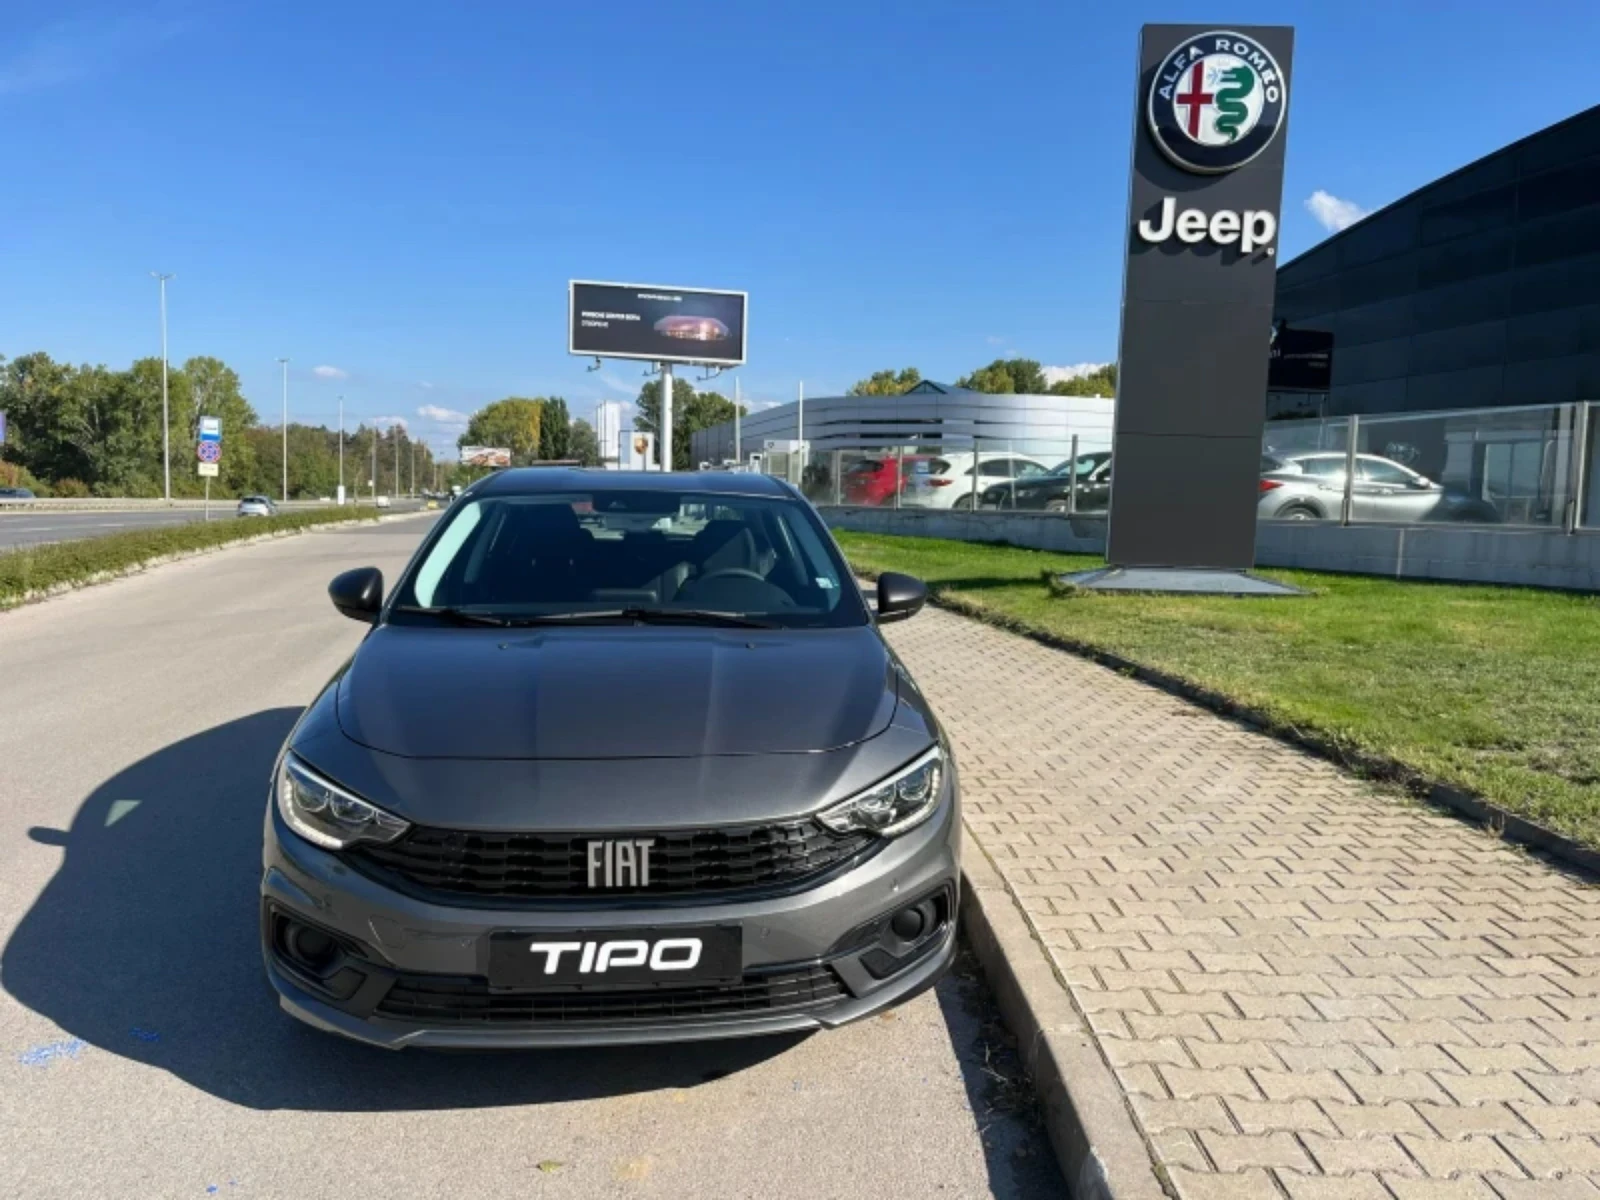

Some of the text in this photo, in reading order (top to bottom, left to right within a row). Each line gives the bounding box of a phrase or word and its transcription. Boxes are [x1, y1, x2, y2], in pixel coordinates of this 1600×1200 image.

[1159, 38, 1279, 103] ALFA ROMEO
[1138, 196, 1276, 254] Jeep
[587, 839, 655, 888] FIAT
[529, 938, 703, 975] TIPO
